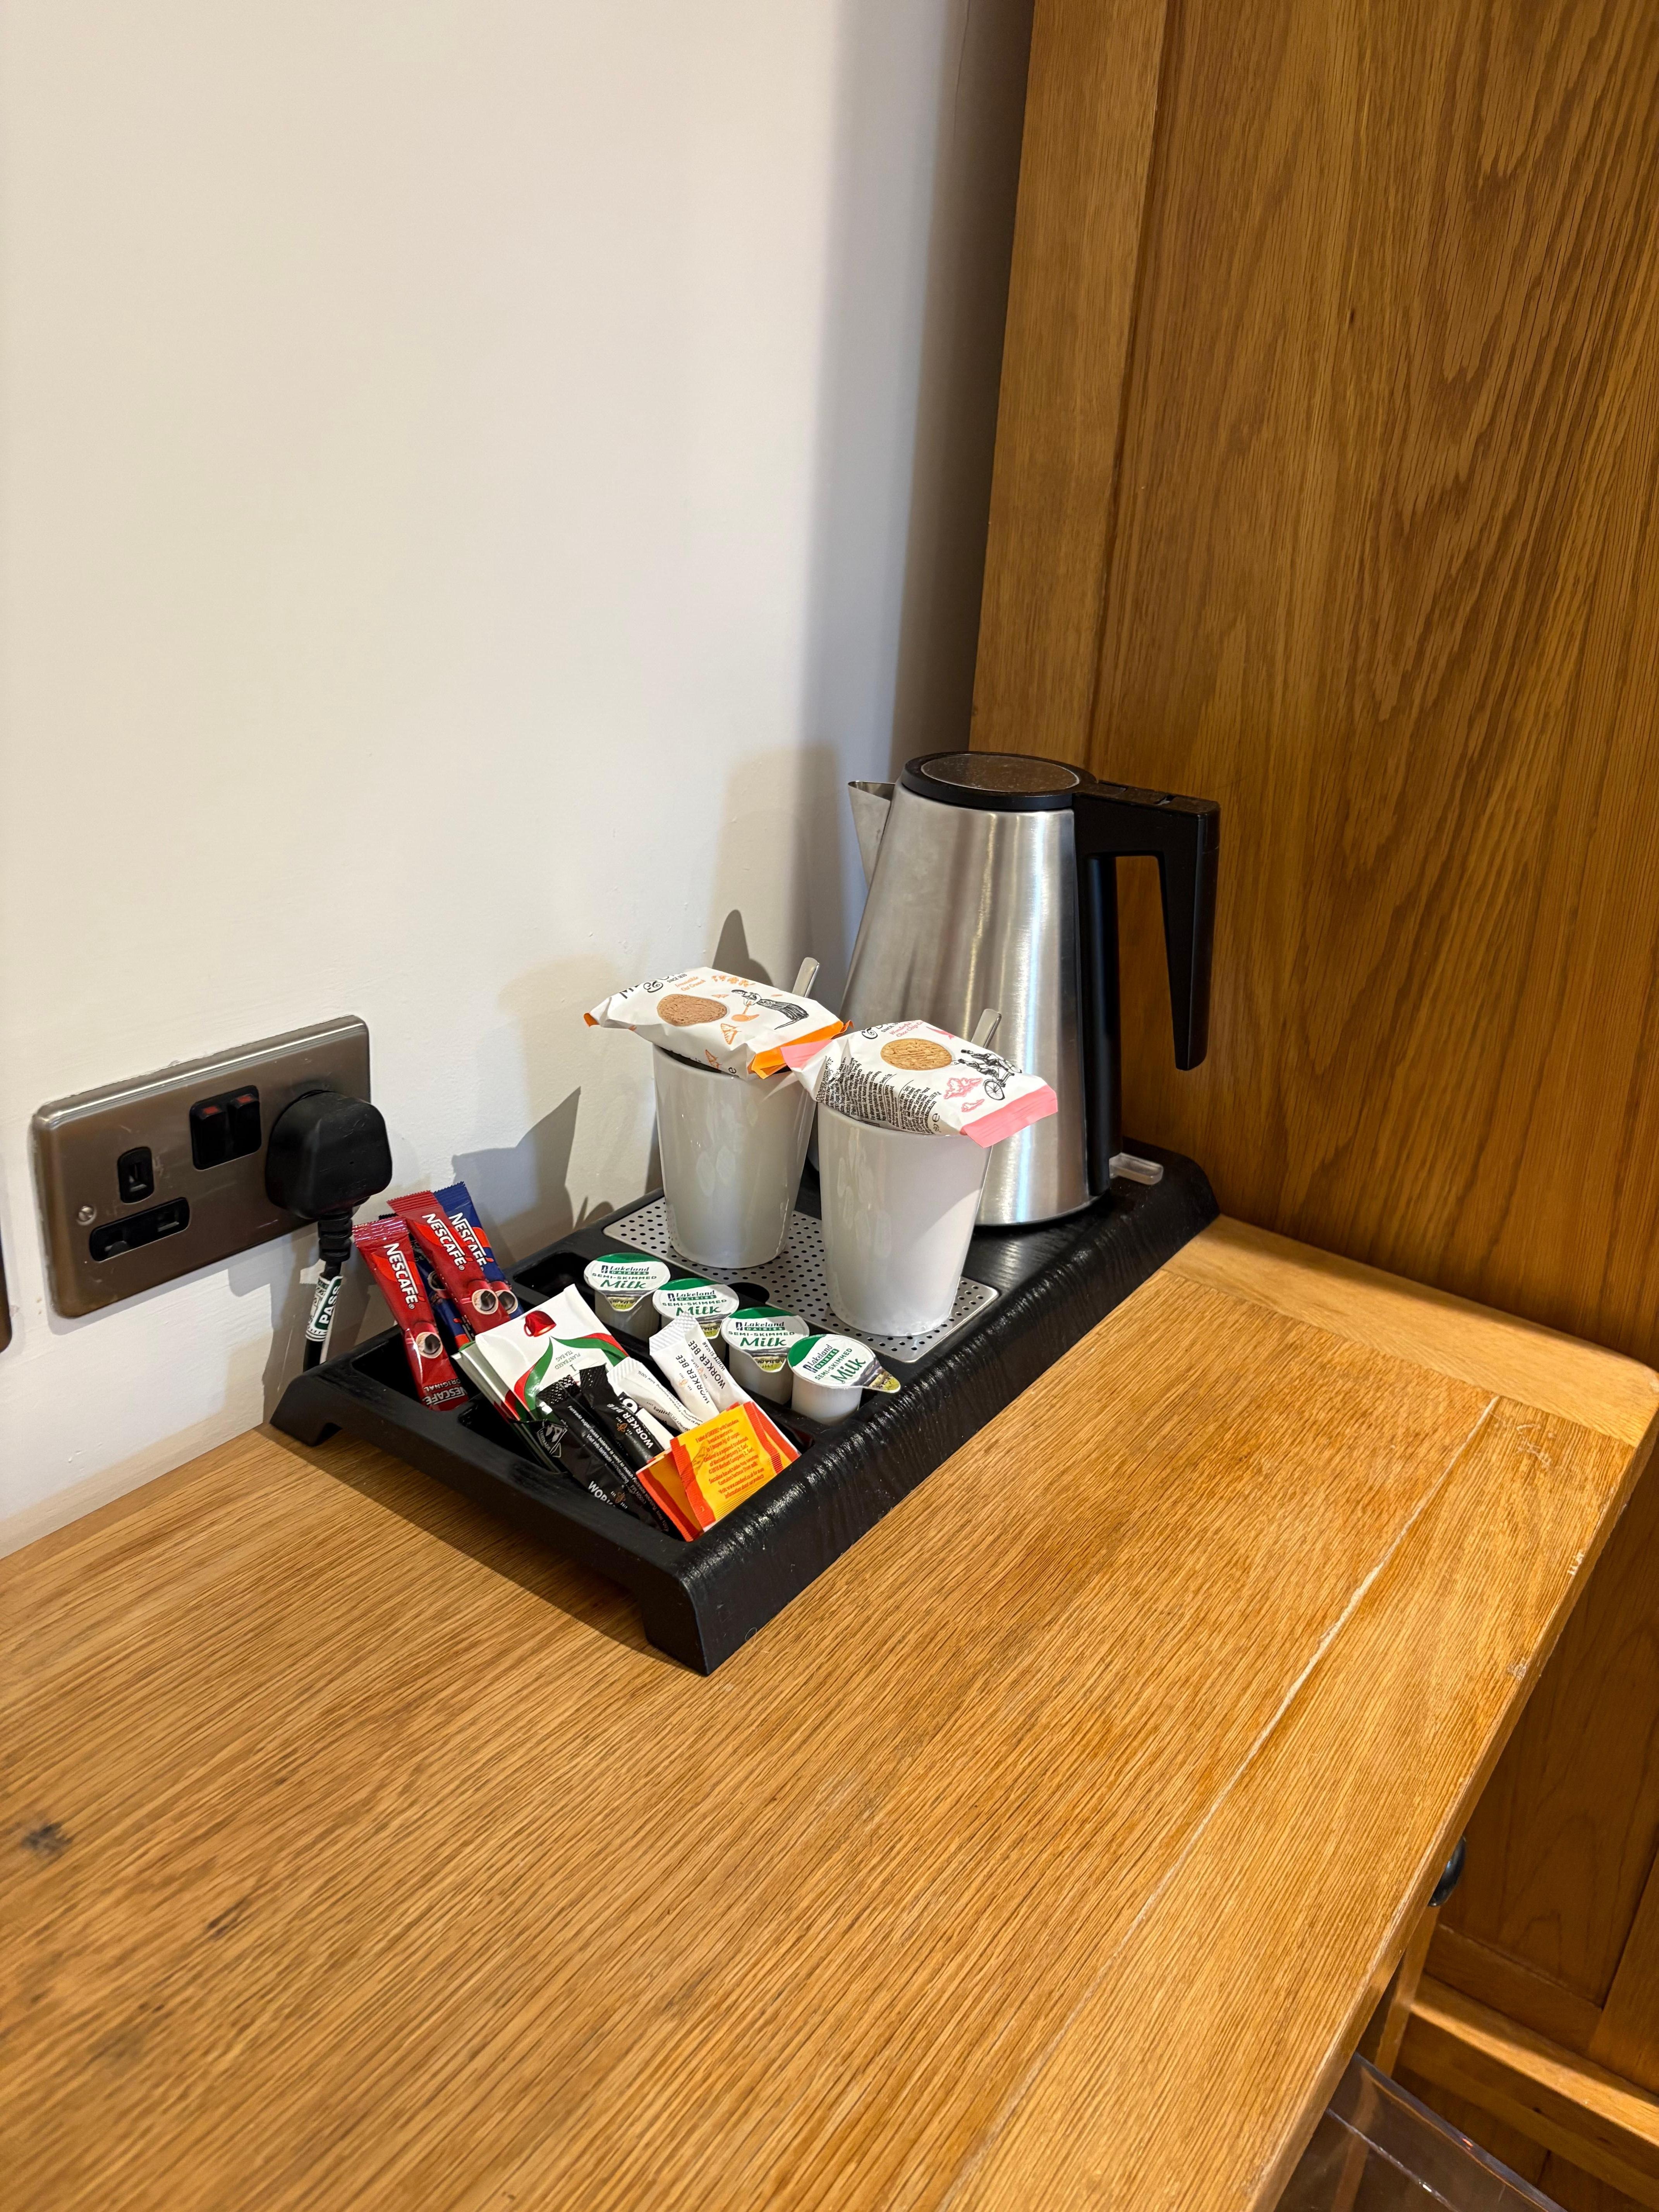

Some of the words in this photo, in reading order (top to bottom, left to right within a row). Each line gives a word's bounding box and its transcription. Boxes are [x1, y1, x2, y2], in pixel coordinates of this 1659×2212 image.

[600, 1279, 646, 1288] Milk
[318, 1285, 341, 1324] PASS
[662, 1298, 727, 1307] SEMI-SKIMMED
[675, 1304, 721, 1316] Milk
[688, 1340, 701, 1355] BEE
[740, 1337, 787, 1346] Milk
[555, 1353, 565, 1362] BAG
[567, 1352, 581, 1362] PLANT
[807, 1343, 833, 1366] Lakeland
[815, 1349, 838, 1369] DAIRIES
[554, 1358, 569, 1370] BASED
[569, 1363, 577, 1372] 1
[676, 1355, 689, 1368] BEE
[814, 1349, 852, 1380] SEMI-SKIMMED
[699, 1353, 725, 1389] WORKER
[830, 1358, 866, 1384] Milk
[423, 1378, 461, 1391] ORIGINAL
[687, 1368, 709, 1403] WORKER
[622, 1412, 654, 1448] WORKER
